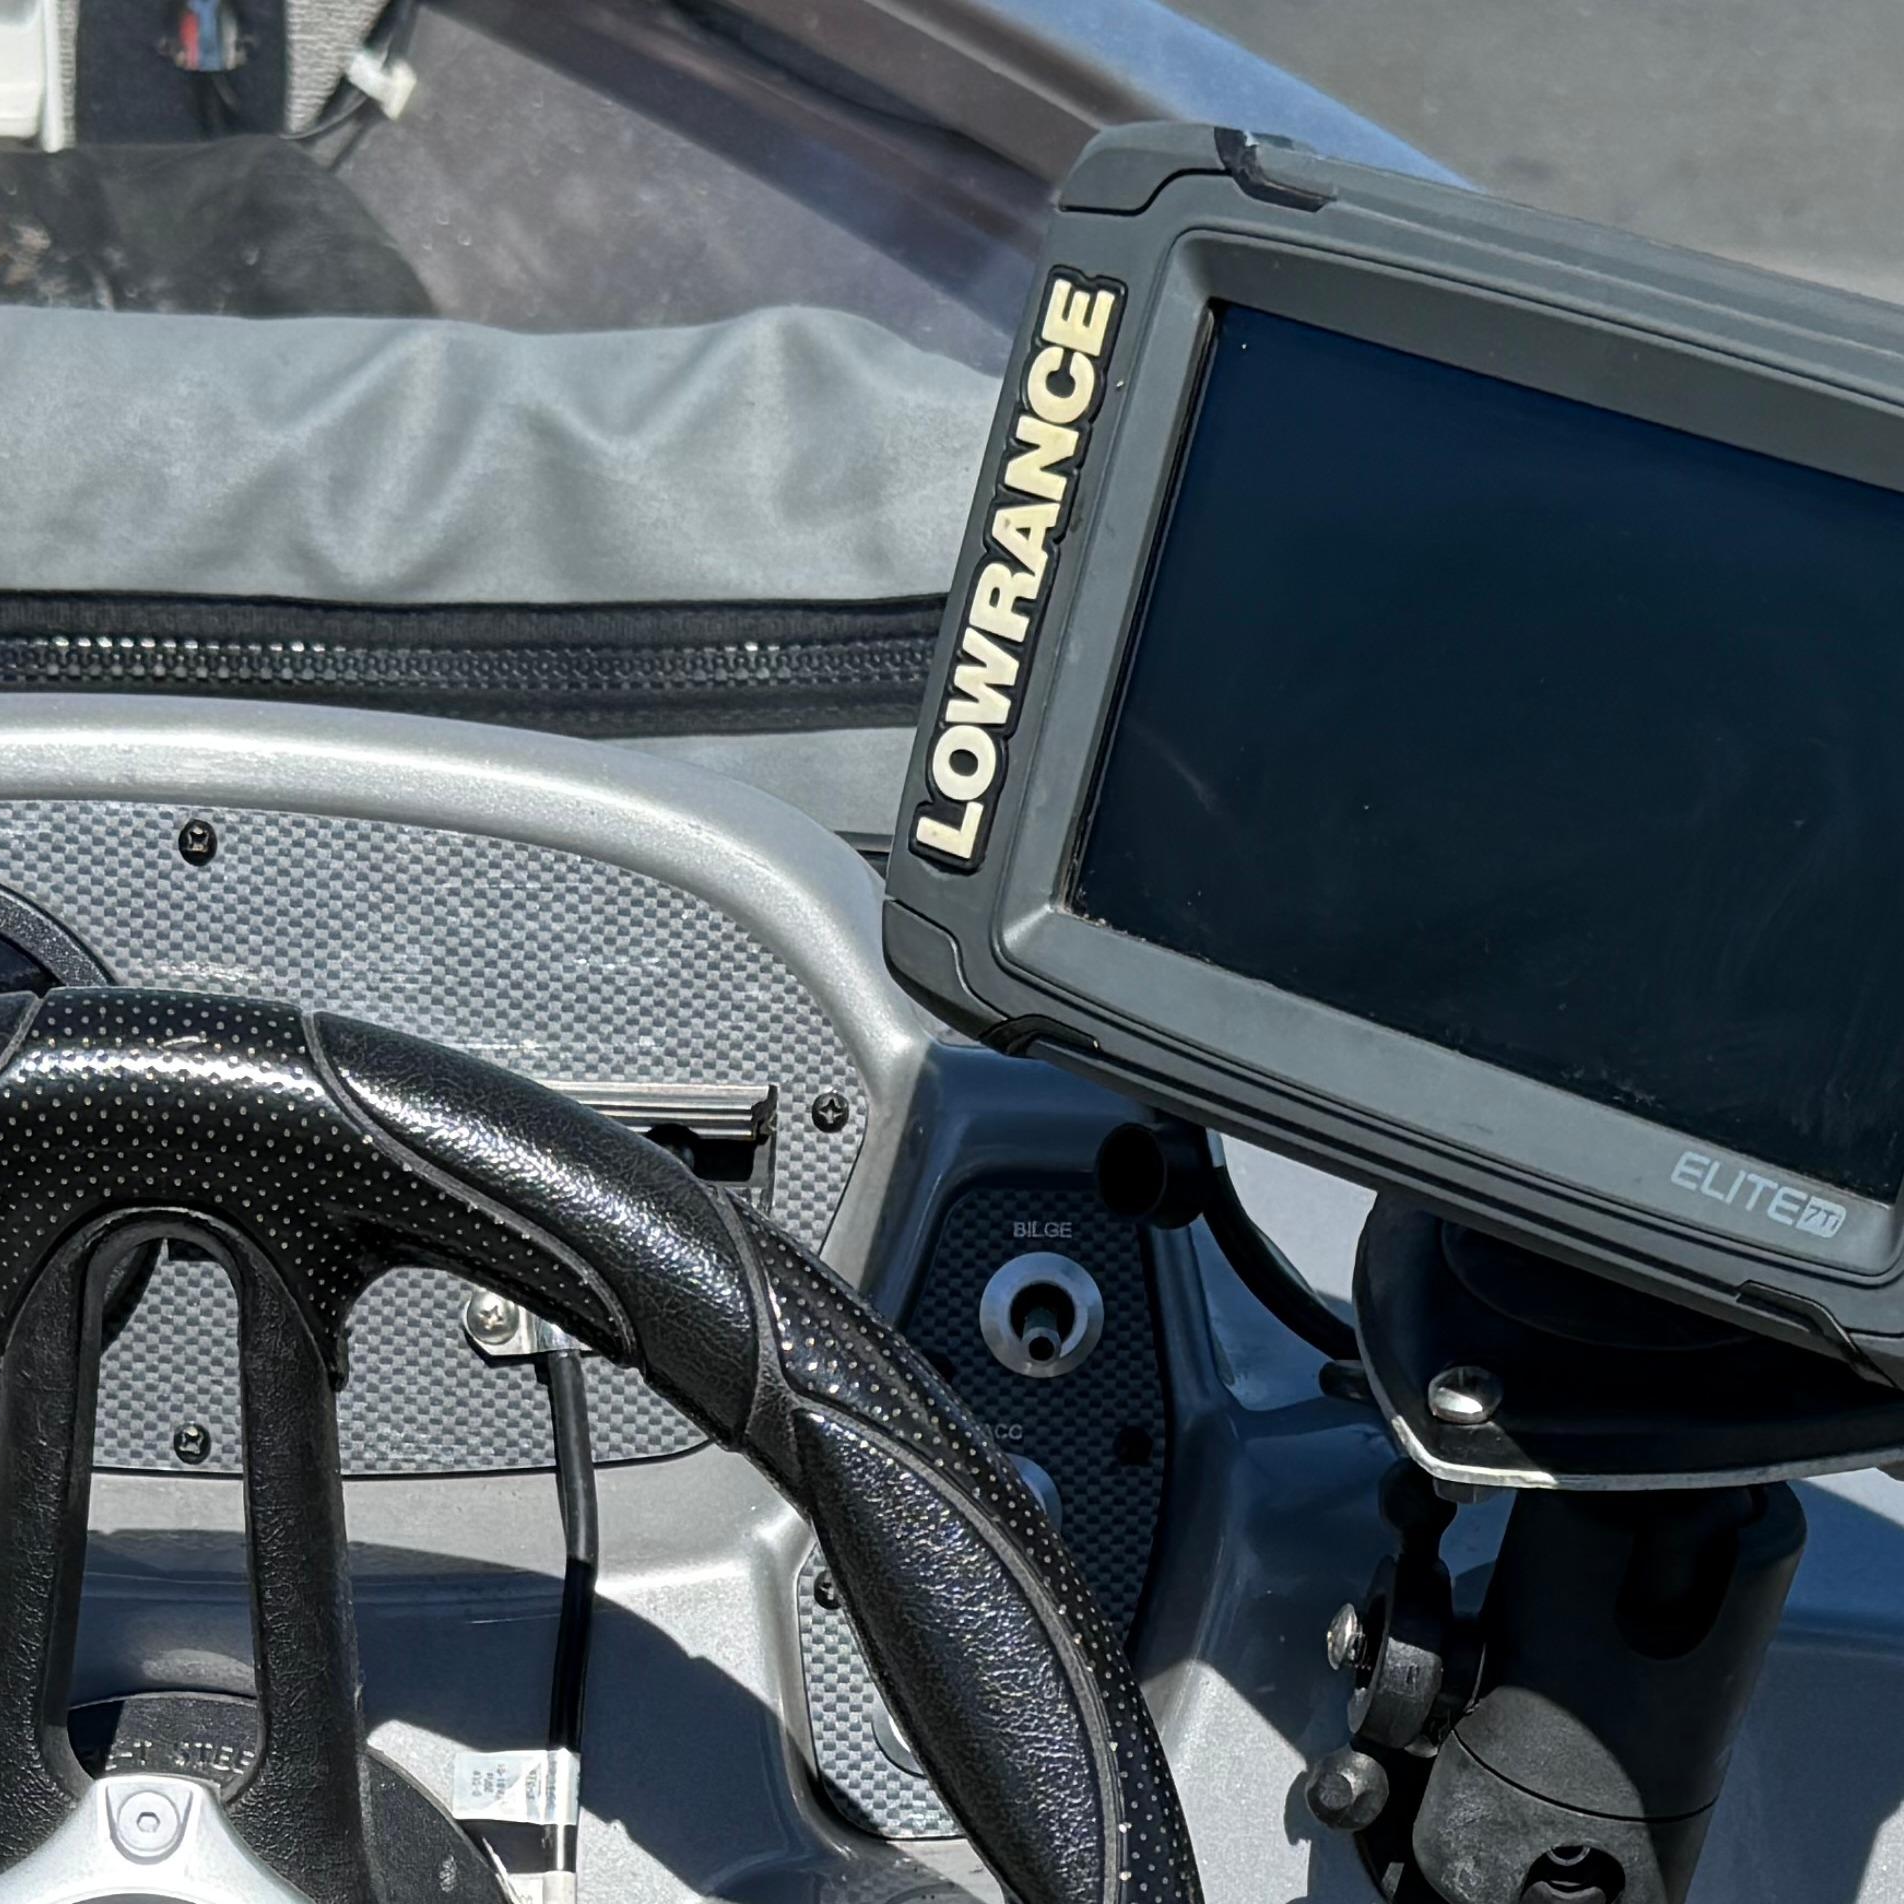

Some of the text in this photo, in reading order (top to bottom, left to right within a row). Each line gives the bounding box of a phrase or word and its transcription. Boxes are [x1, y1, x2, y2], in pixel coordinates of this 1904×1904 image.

[915, 277, 1115, 860] LOWRANCE
[1669, 1150, 1799, 1227] ELITE
[1012, 1220, 1074, 1240] BILGE
